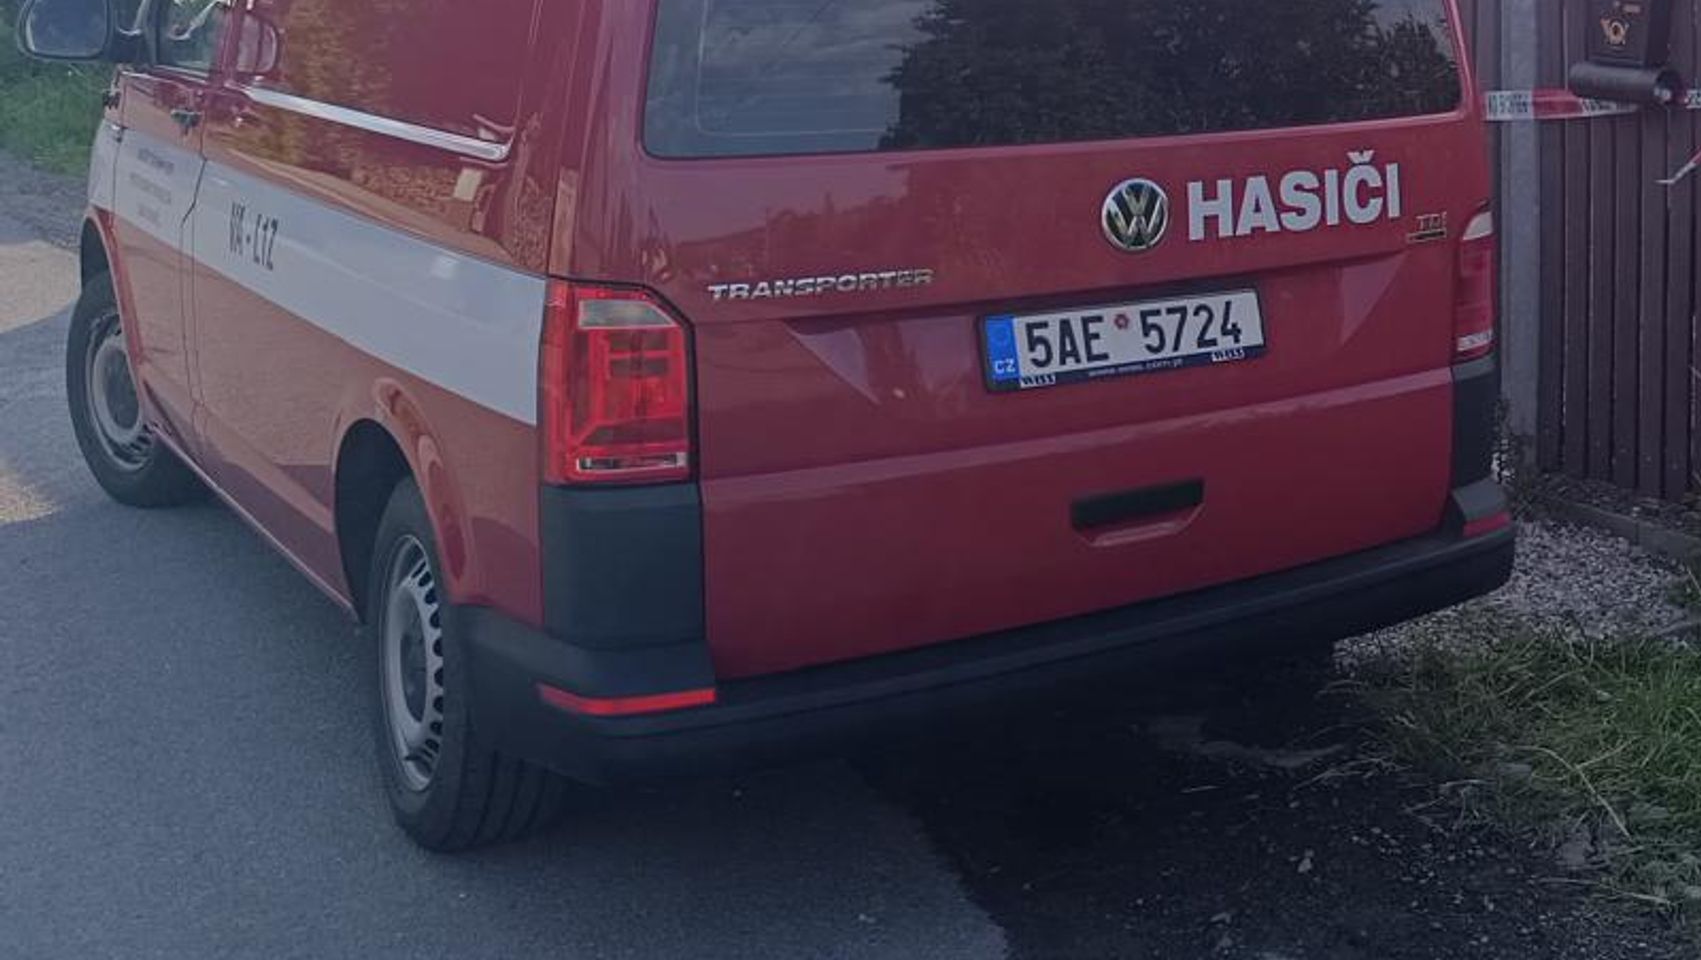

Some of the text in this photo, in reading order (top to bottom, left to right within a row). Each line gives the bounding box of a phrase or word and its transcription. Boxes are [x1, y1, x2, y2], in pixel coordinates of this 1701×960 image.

[1187, 150, 1400, 241] HASIČI
[708, 269, 934, 300] TRANSPORTER
[1025, 301, 1242, 368] 5AE 5724
[994, 359, 1016, 375] CZ
